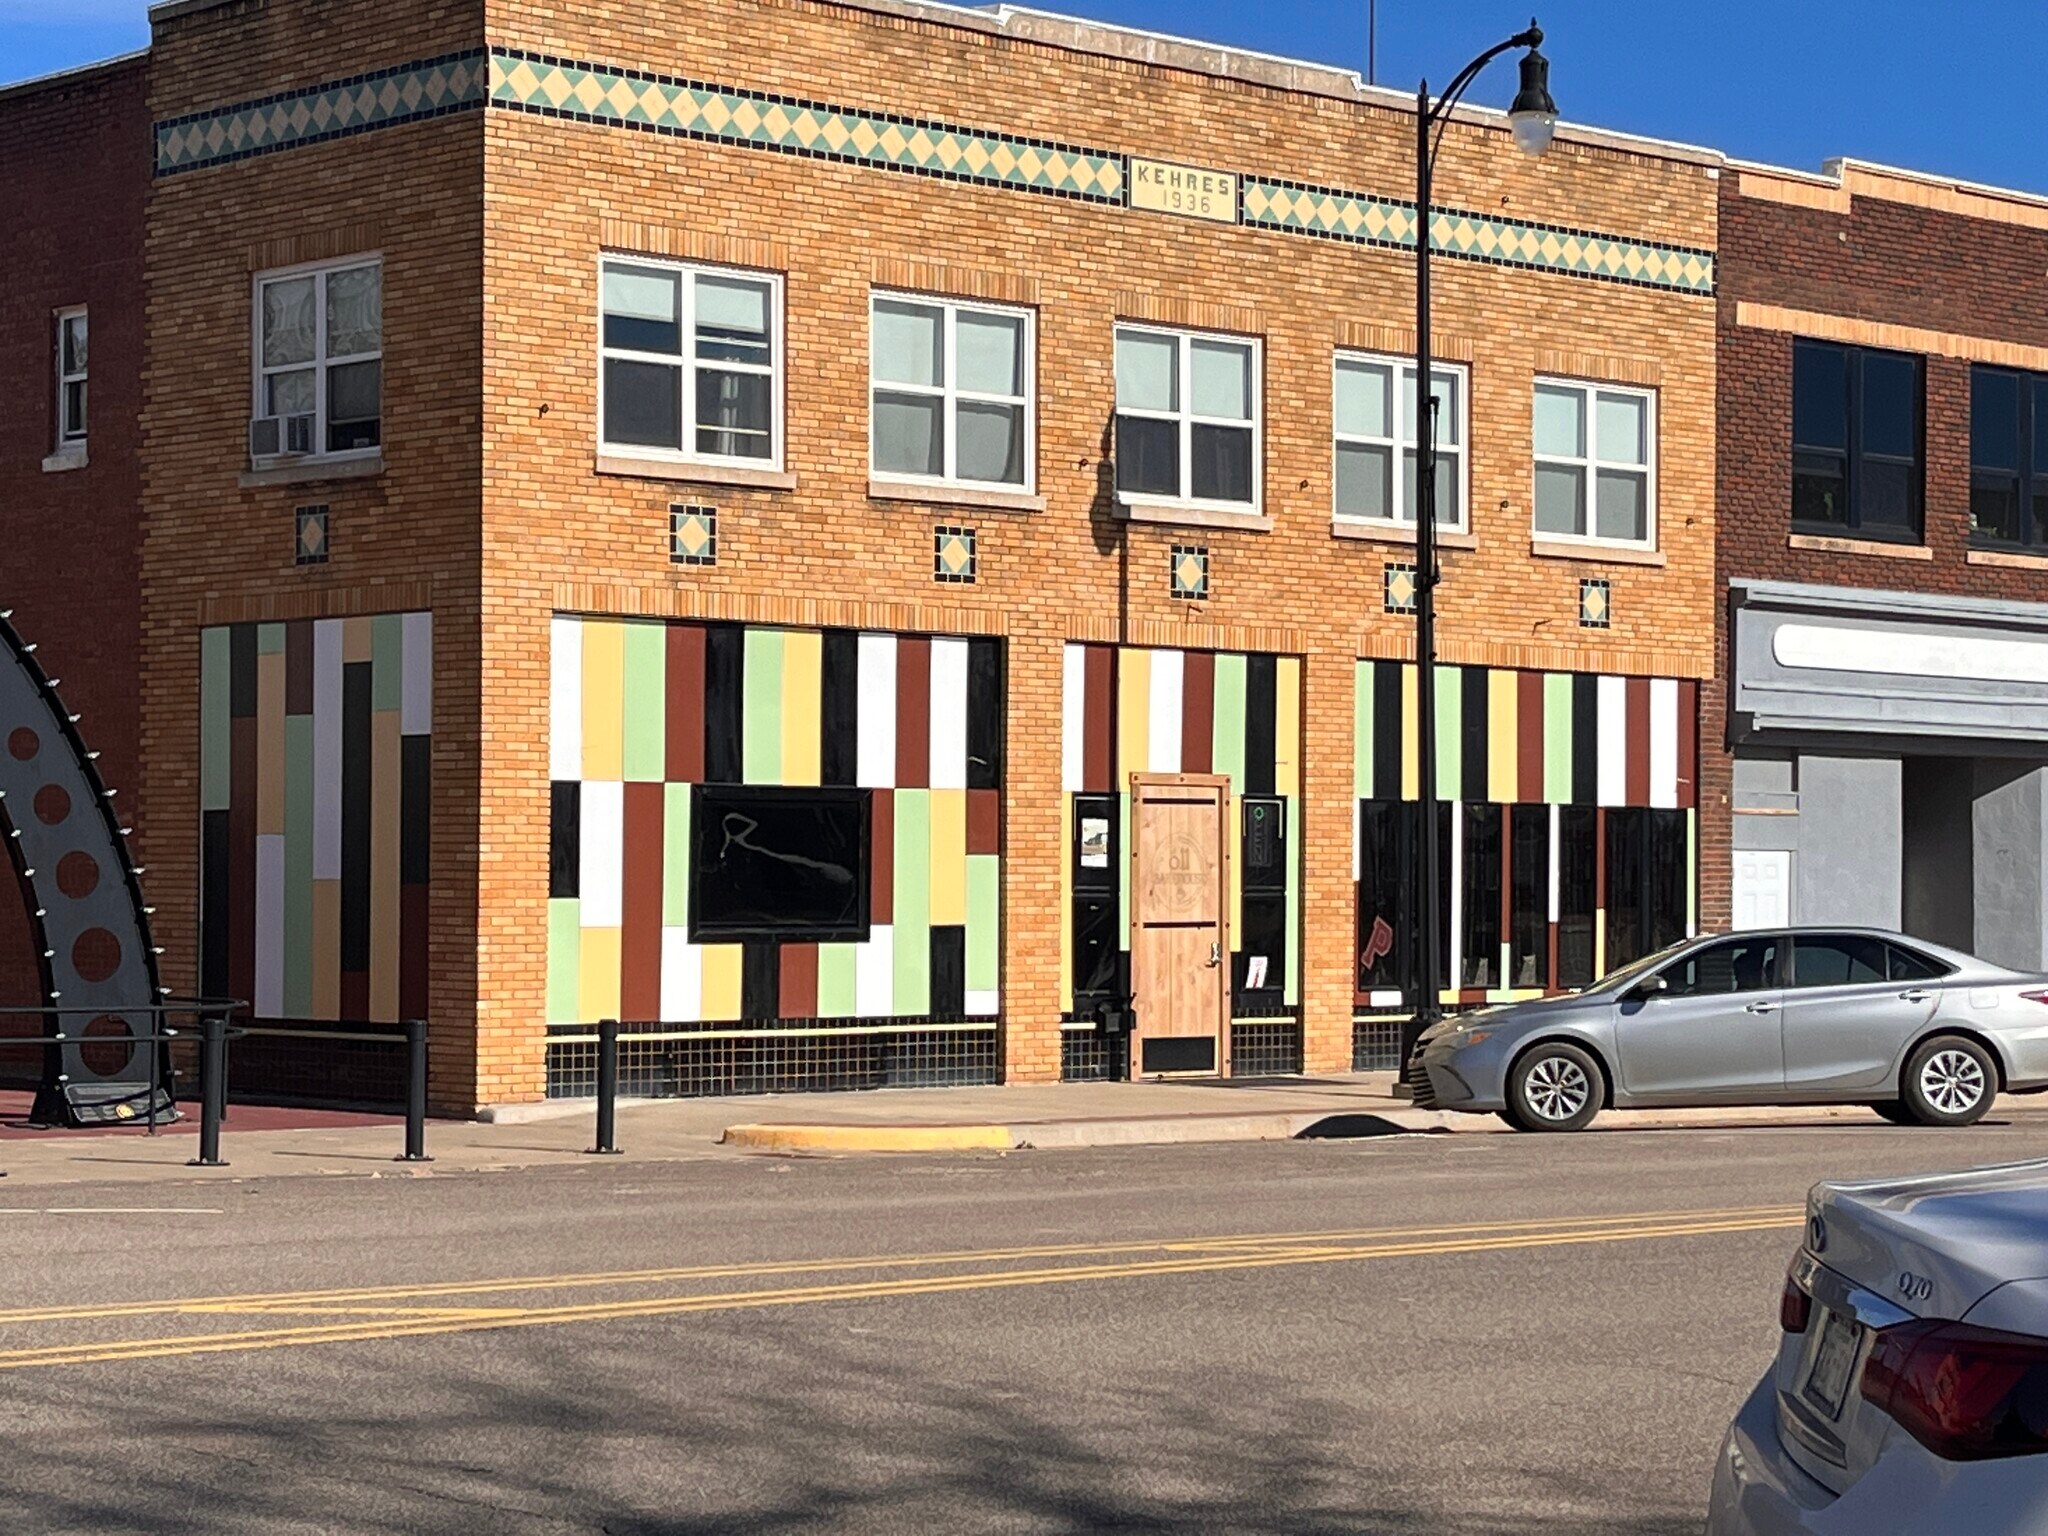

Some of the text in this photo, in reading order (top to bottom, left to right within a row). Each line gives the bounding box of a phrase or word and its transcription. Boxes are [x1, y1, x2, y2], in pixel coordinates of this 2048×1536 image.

[1138, 164, 1229, 196] KEHRES
[1162, 189, 1211, 214] 1936
[1361, 914, 1393, 970] P
[1899, 1271, 1933, 1300] Q70
